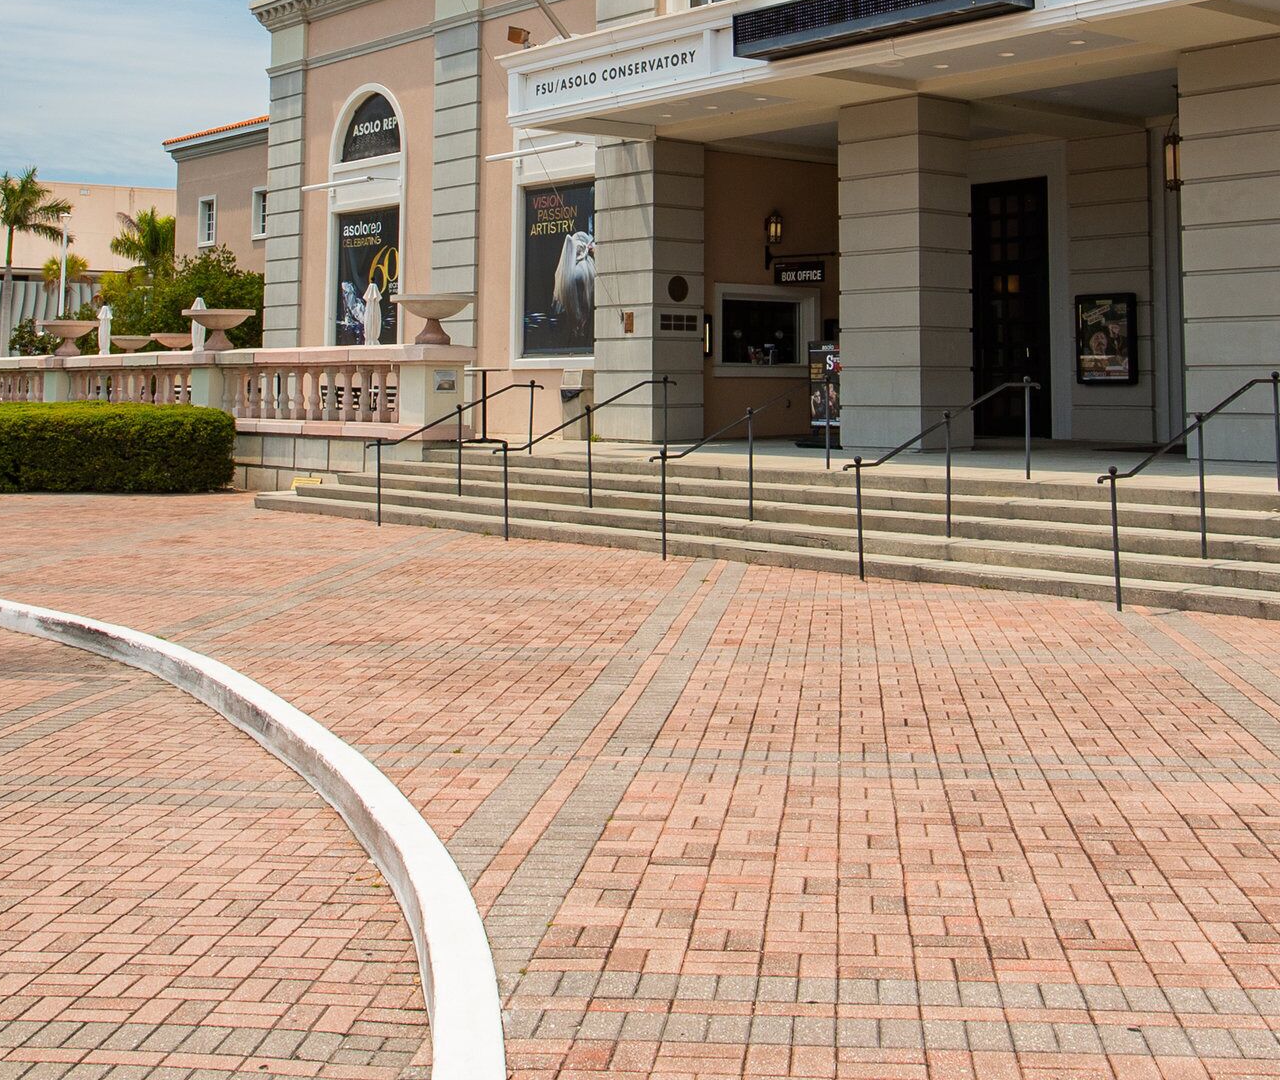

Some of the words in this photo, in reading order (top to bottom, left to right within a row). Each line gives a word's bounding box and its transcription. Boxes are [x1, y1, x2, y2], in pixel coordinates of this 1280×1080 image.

[535, 74, 597, 96] FSU/ASOLO
[601, 50, 696, 82] CONSERVATORY
[352, 119, 381, 137] ASOLO
[382, 116, 398, 131] REP
[532, 194, 564, 209] VISION
[537, 205, 578, 222] PASSION
[530, 219, 575, 236] ARTISTRY
[342, 235, 382, 248] CELEBRATING
[368, 244, 399, 294] 60
[781, 271, 796, 282] BOX
[797, 270, 822, 281] OFFICE
